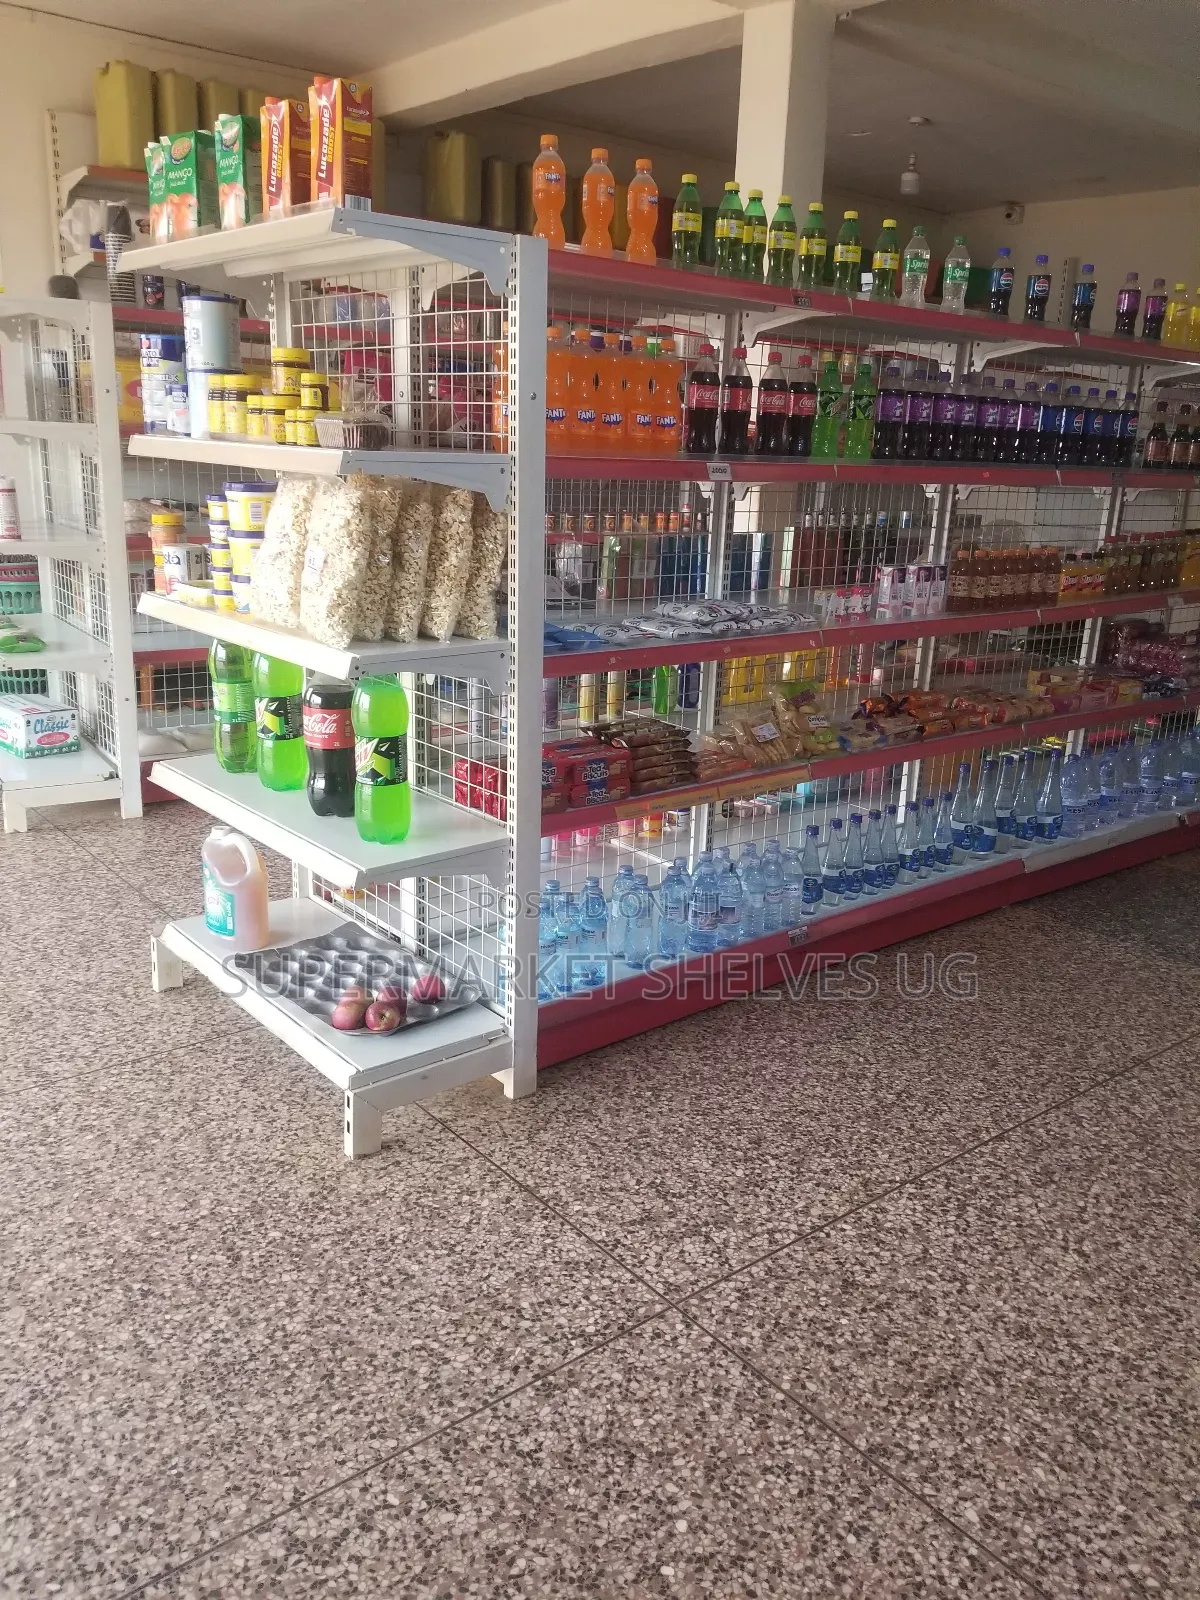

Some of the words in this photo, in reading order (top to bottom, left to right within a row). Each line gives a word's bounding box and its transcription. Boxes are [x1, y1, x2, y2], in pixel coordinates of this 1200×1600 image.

[317, 108, 330, 179] Lucozade
[326, 126, 335, 163] BOOST
[220, 154, 239, 169] MANGO
[268, 127, 280, 193] Lucozade
[167, 168, 193, 181] MANGO
[34, 718, 69, 735] Classic
